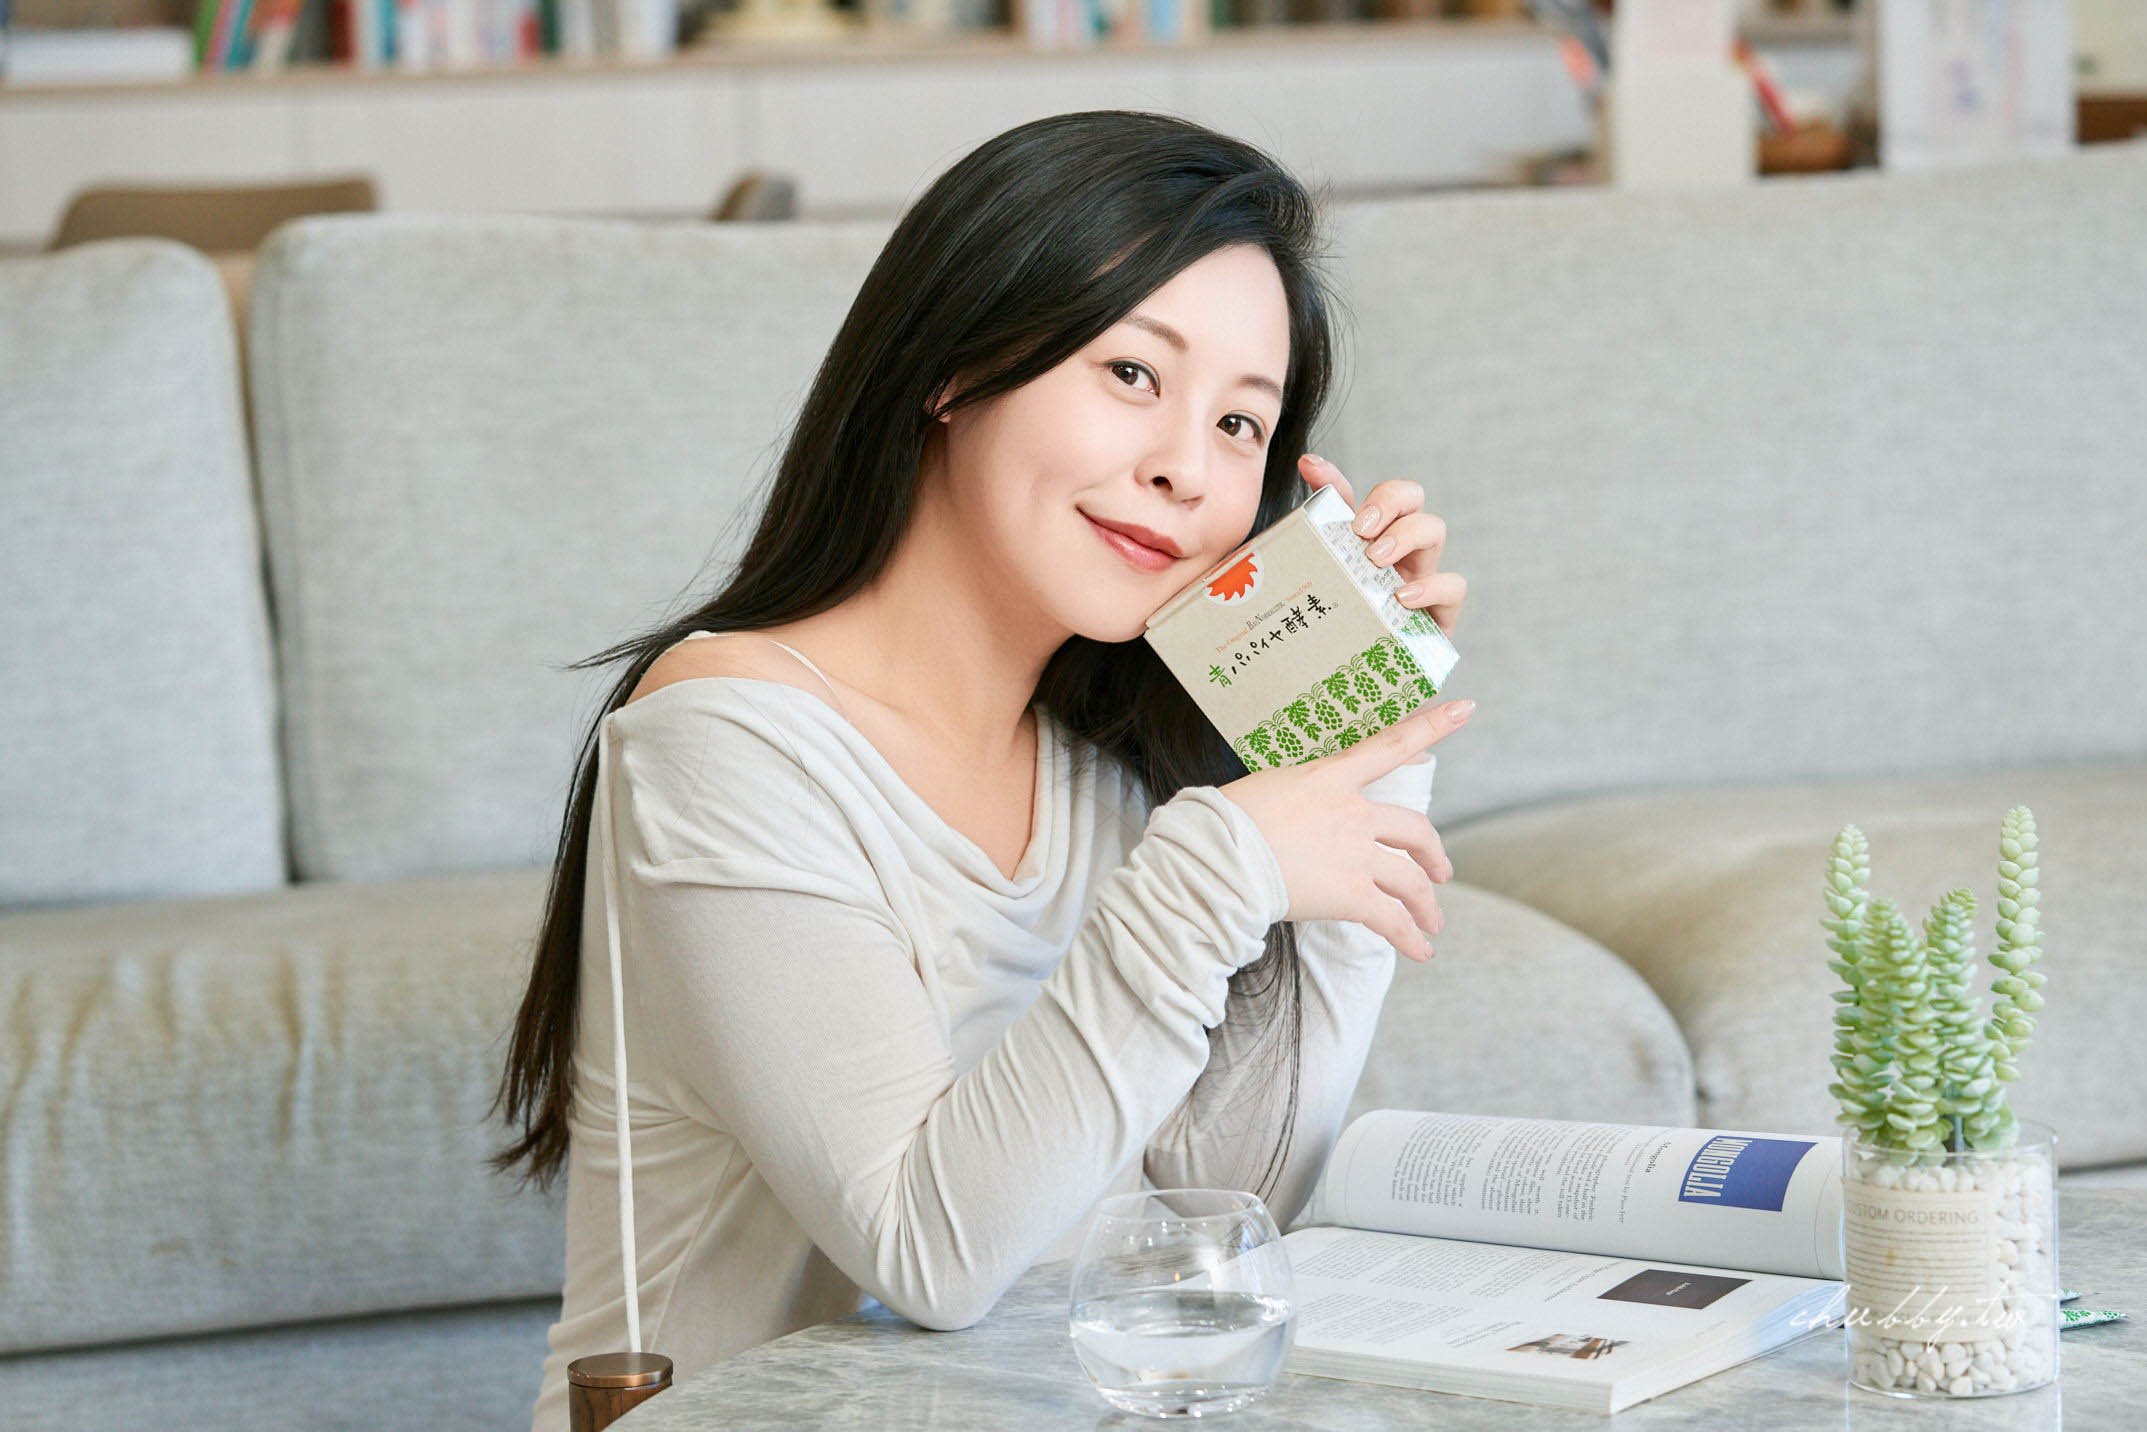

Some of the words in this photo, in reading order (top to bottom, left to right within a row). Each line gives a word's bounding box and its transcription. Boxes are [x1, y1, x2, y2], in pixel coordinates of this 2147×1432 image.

[1645, 1140, 1672, 1173] Mongolia
[1683, 1137, 1753, 1197] MONGOLIA
[1894, 1209, 1979, 1225] ORDERING
